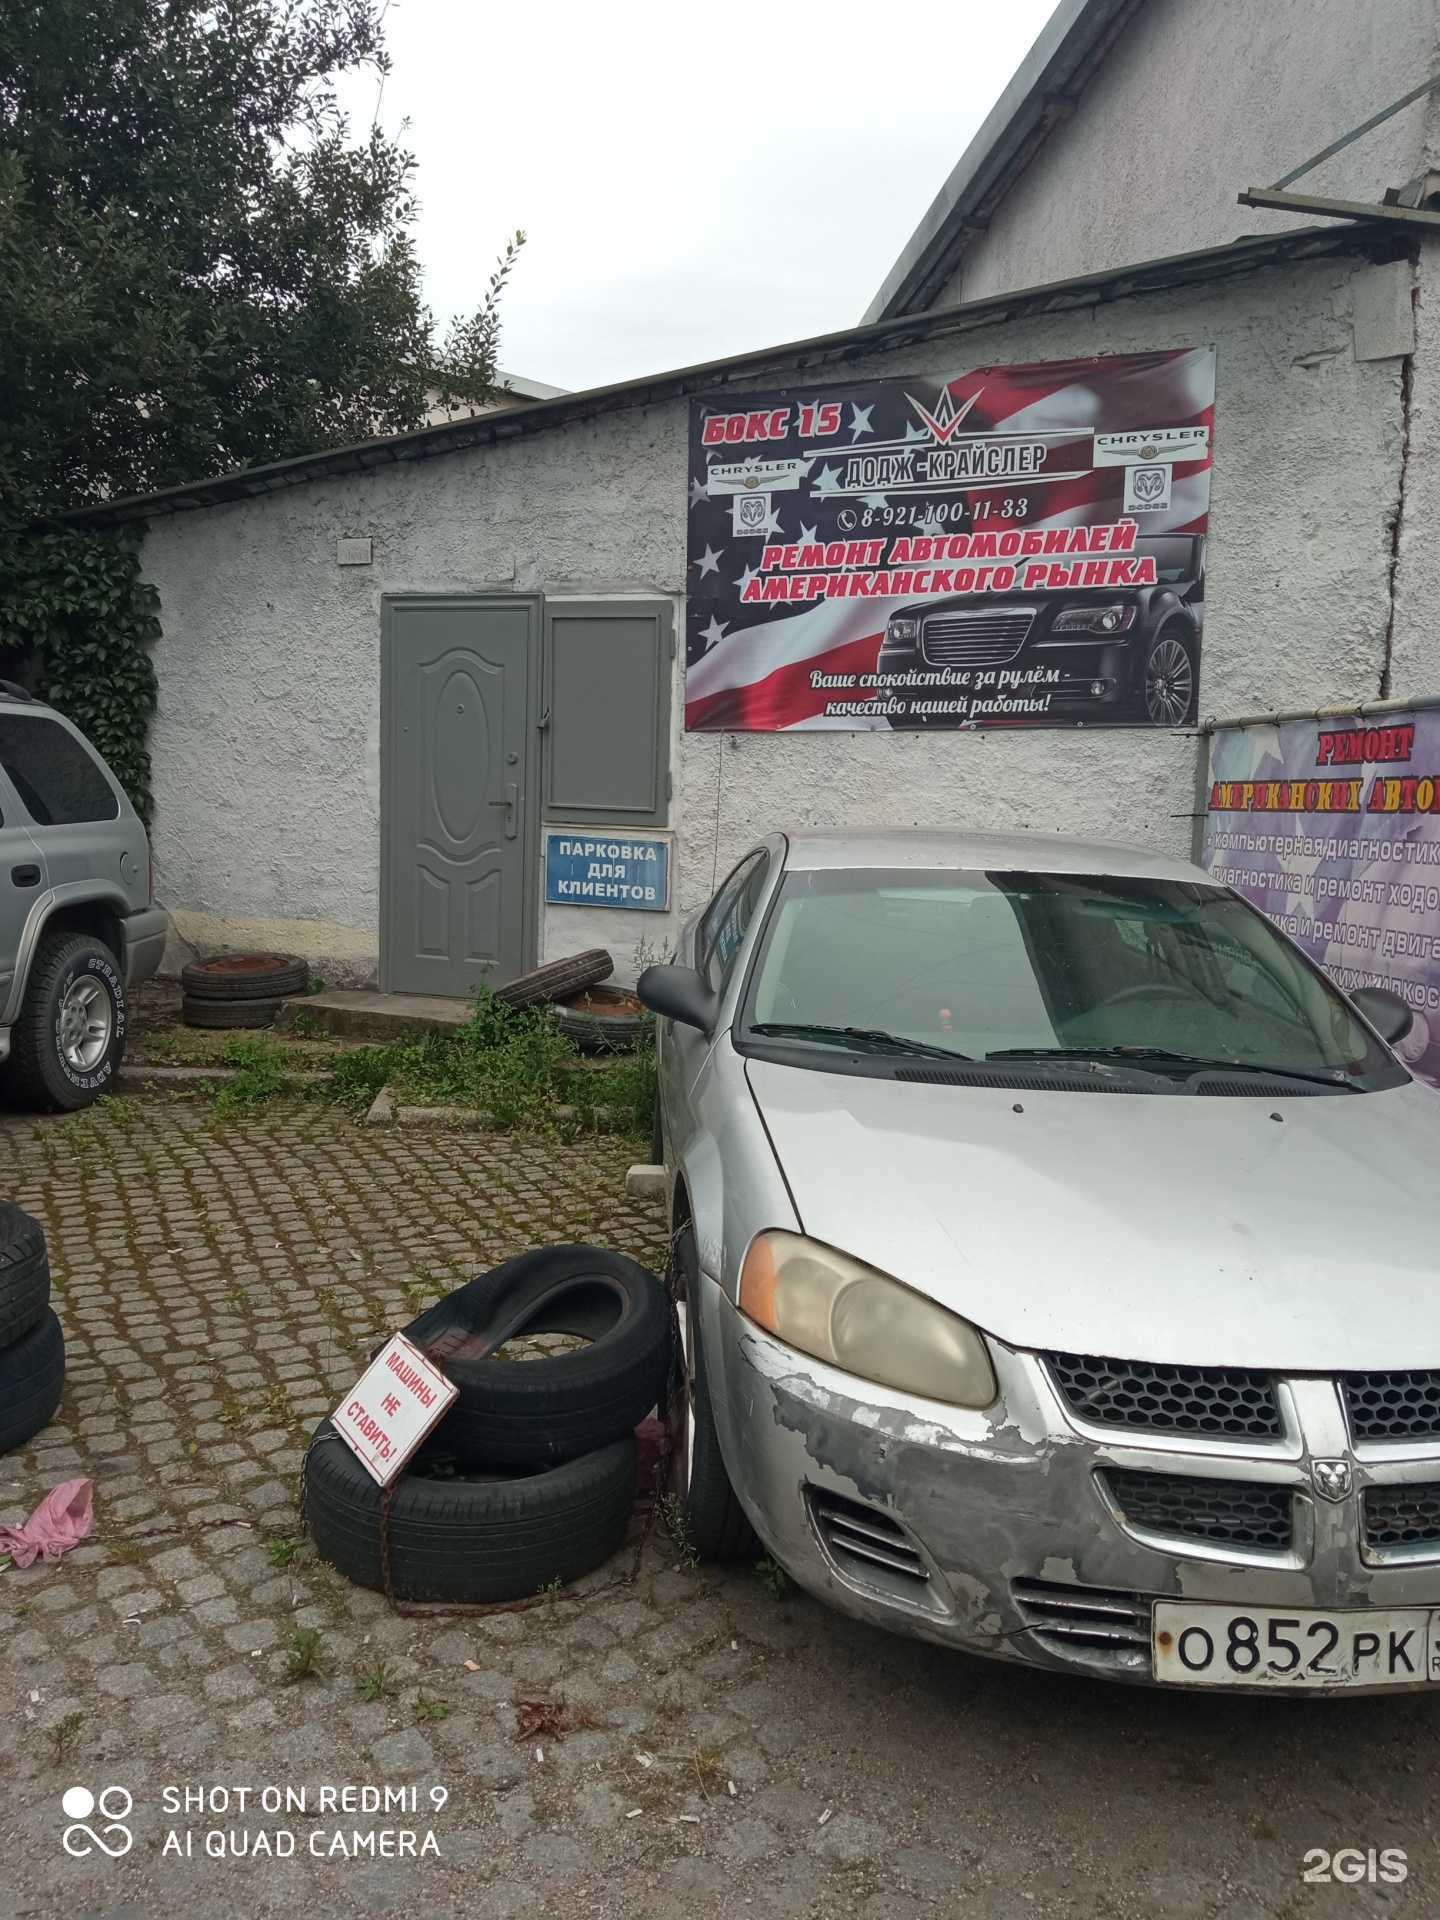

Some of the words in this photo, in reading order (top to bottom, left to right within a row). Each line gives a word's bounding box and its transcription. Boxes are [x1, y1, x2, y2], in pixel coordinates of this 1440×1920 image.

[702, 408, 790, 445] БОКС
[798, 403, 842, 437] 15
[1097, 430, 1206, 446] CHRYSLER
[710, 462, 797, 475] CHRYSLER
[845, 444, 1047, 488] ДОДЖ-КРАЙСЛЕР
[861, 498, 1028, 528] 8-921-100-11-33
[760, 538, 887, 571] РЕМОНТ
[888, 519, 1139, 566] АВТОМОБИЛЕЙ
[740, 565, 1020, 603] АМЕРИКАНСКОГО
[1021, 555, 1158, 591] РЫНКА
[810, 670, 857, 688] Ваше
[860, 666, 971, 688] спокойствие
[974, 671, 996, 690] за
[997, 665, 1060, 690] рулём
[826, 696, 906, 715] качество
[909, 696, 968, 714] нашей
[969, 693, 1052, 718] работы!
[1316, 723, 1415, 766] РЕМОНТ
[1208, 777, 1364, 813] АМЕРИКАНСКИХ
[560, 842, 656, 861] ПАРКОВКА
[1214, 832, 1324, 860] компьютерная
[1326, 838, 1440, 865] диагностик
[588, 863, 625, 879] ДЛЯ
[558, 880, 656, 900] КЛИЕНТОВ
[1303, 874, 1315, 896] и
[1316, 876, 1386, 903] ремонт
[1387, 882, 1440, 914] ходо
[1300, 916, 1312, 938] и
[1313, 920, 1382, 949] ремонт
[385, 1351, 438, 1409] МАШИНЫ
[380, 1392, 402, 1418] НЕ
[347, 1401, 398, 1463] СТАВИТЬ!
